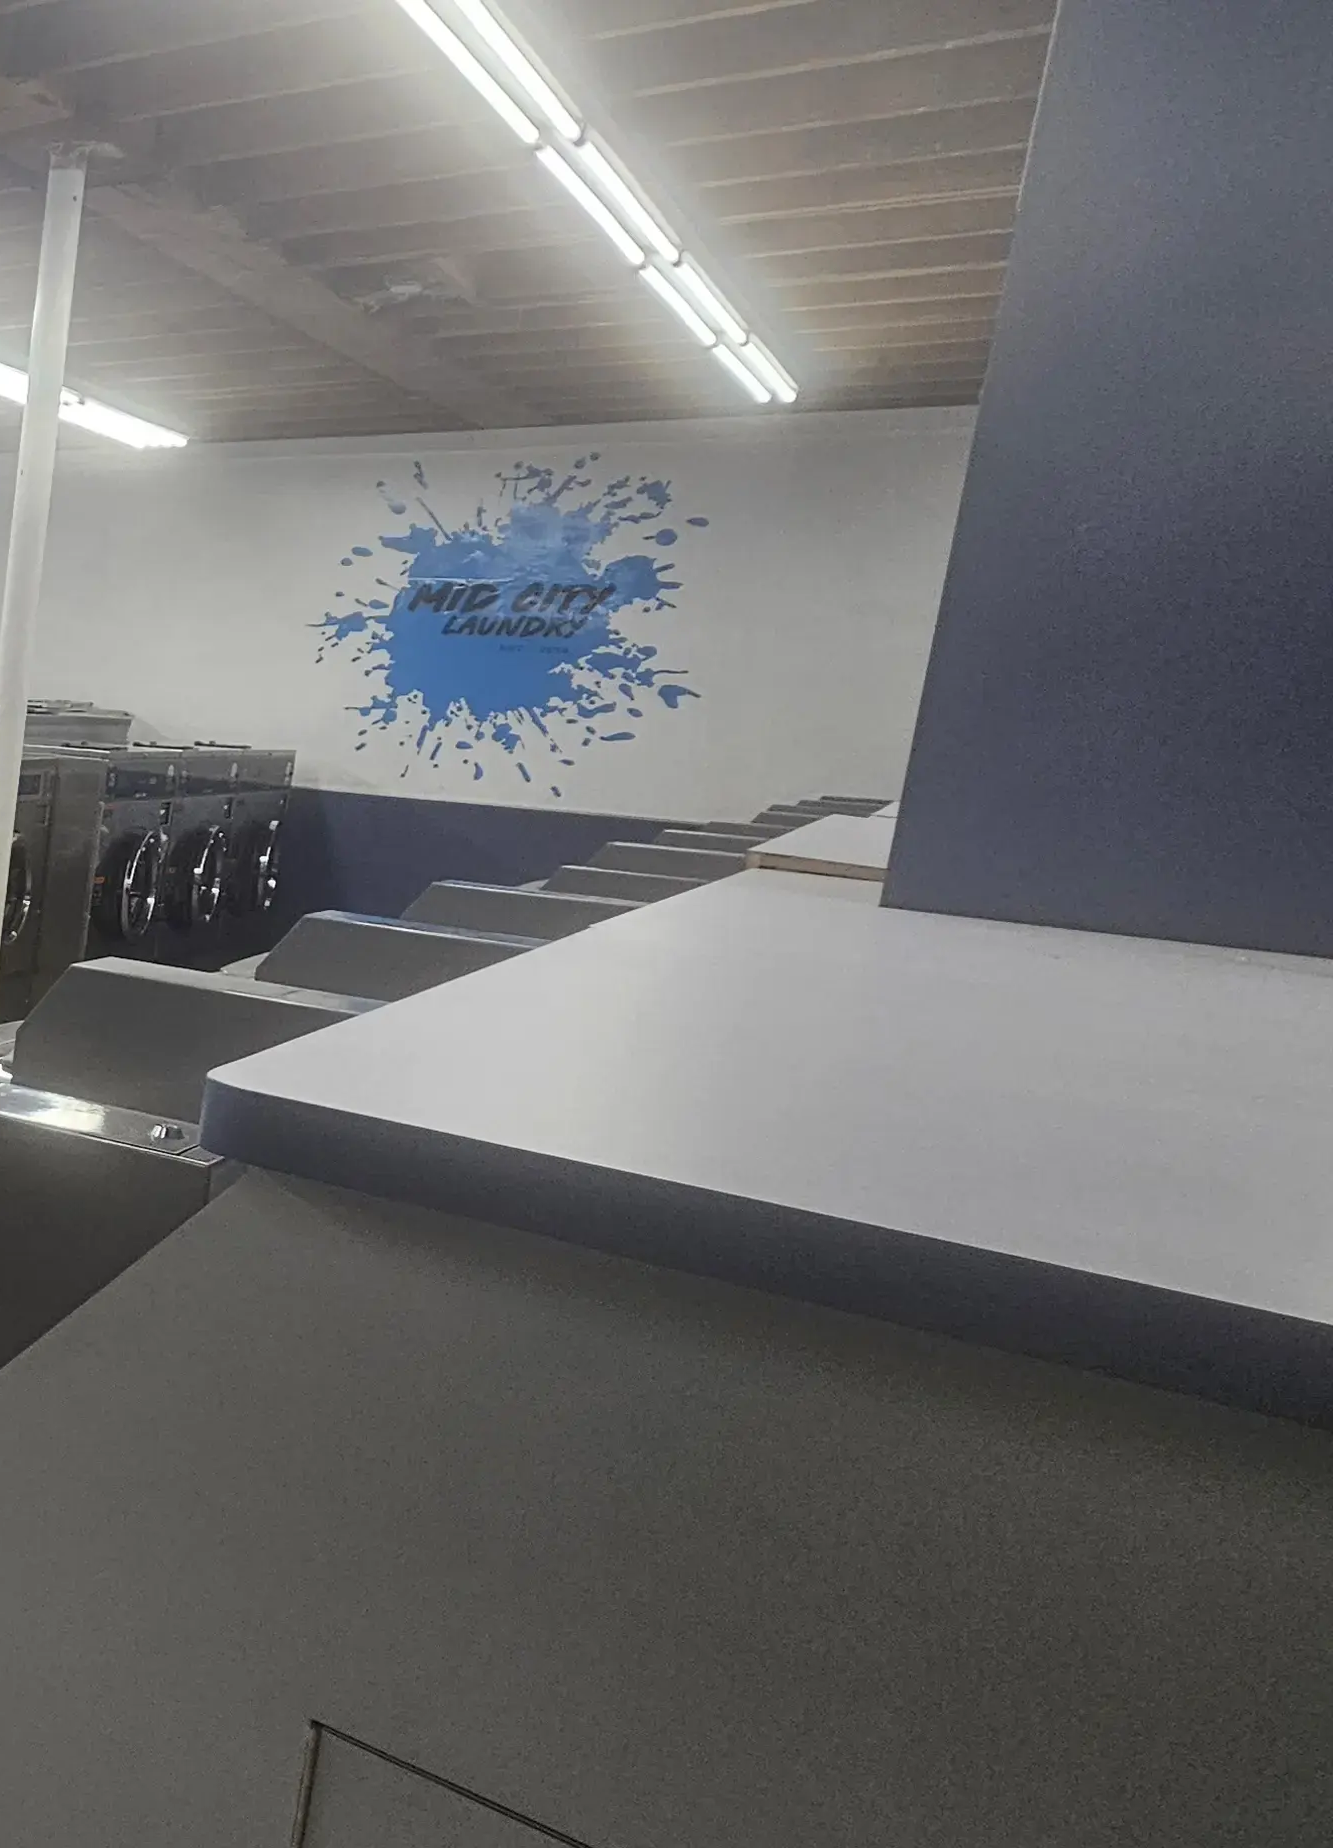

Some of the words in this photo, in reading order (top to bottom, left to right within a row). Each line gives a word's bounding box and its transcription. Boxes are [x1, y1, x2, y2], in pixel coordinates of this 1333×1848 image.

[407, 581, 501, 614] MID
[511, 581, 617, 615] CITY
[441, 614, 590, 638] LAUNDRY
